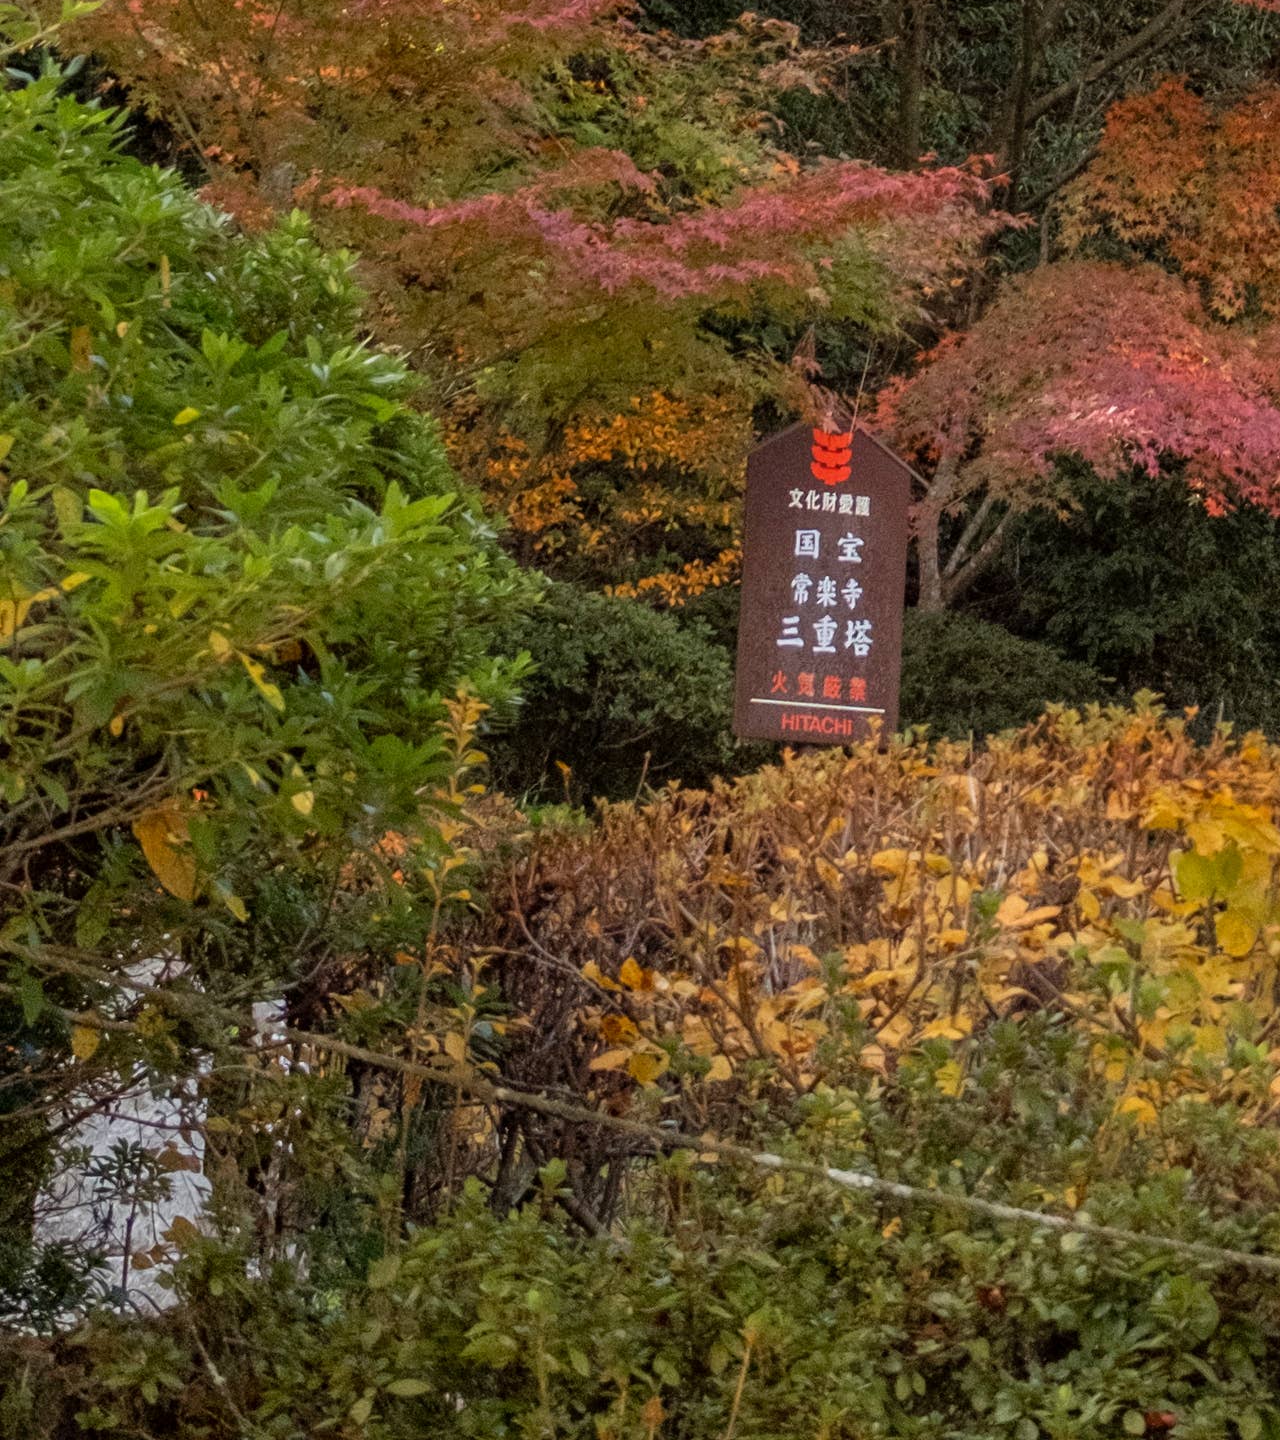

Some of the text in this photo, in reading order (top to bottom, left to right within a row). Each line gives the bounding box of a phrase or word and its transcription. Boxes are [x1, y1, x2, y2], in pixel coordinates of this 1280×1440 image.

[795, 529, 865, 563] 国宝
[791, 572, 863, 610] 常楽寺
[777, 614, 873, 657] 三重塔
[781, 713, 853, 736] HITACHI
